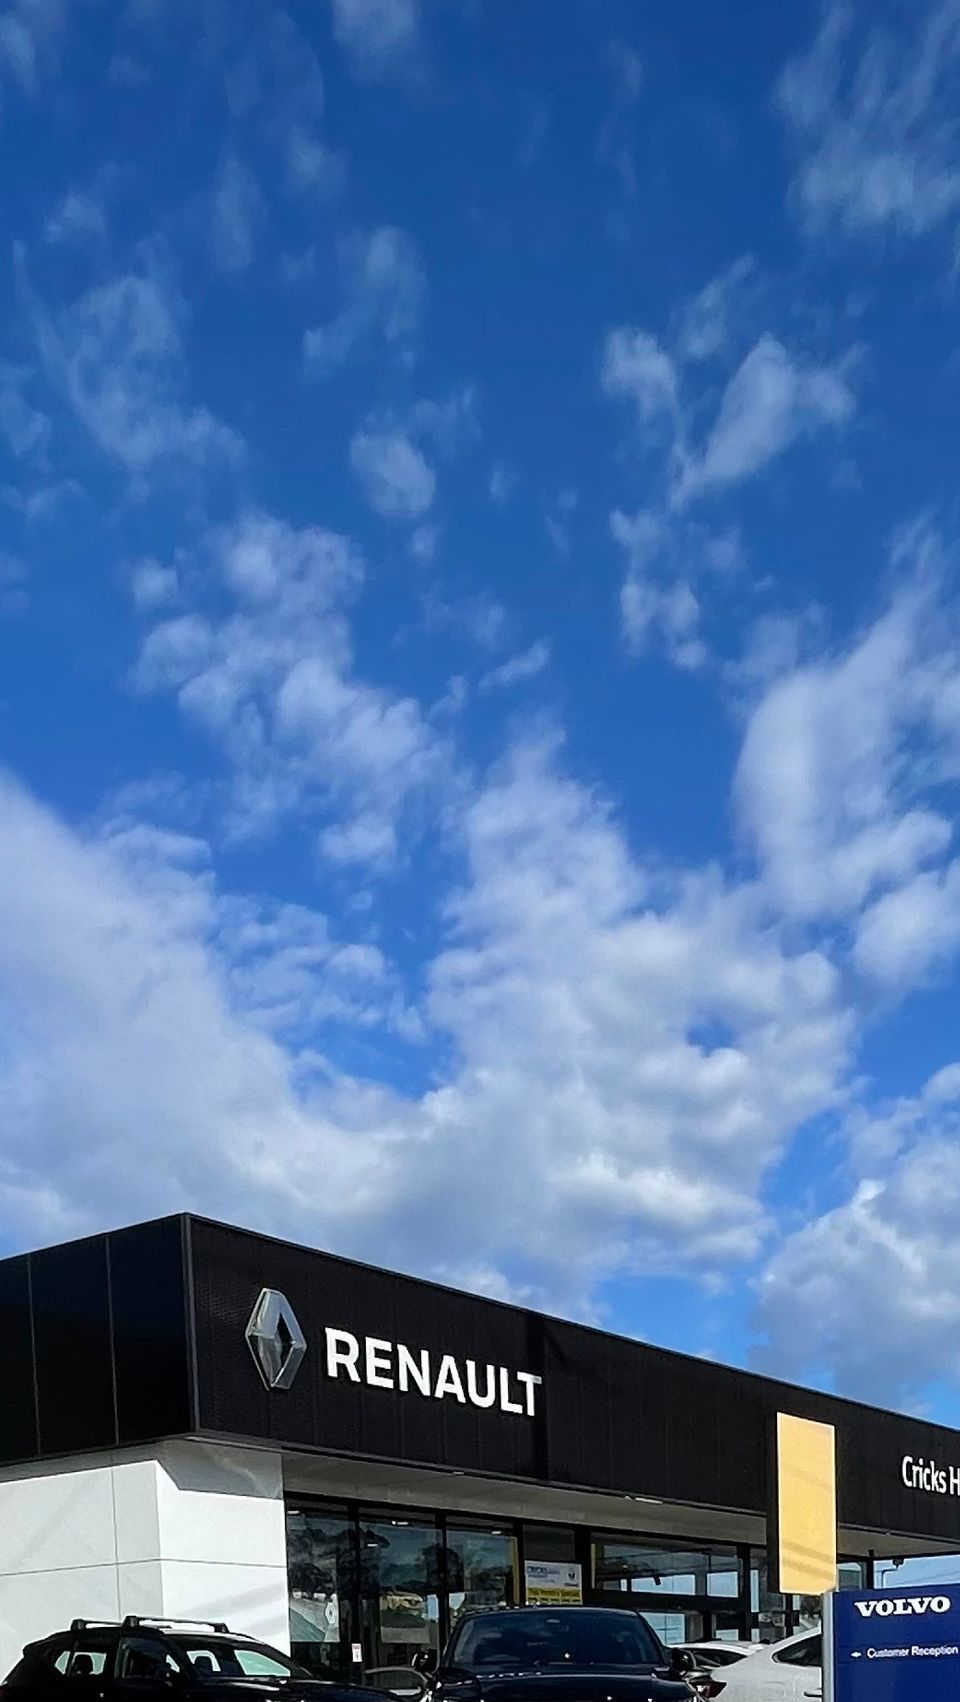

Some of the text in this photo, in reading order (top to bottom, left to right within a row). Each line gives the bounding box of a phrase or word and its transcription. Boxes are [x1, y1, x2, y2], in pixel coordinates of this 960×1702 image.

[324, 1326, 543, 1417] RENAULT
[902, 1455, 947, 1494] Cricks
[854, 1596, 951, 1617] VOLVO
[867, 1645, 959, 1658] Customer Reception
